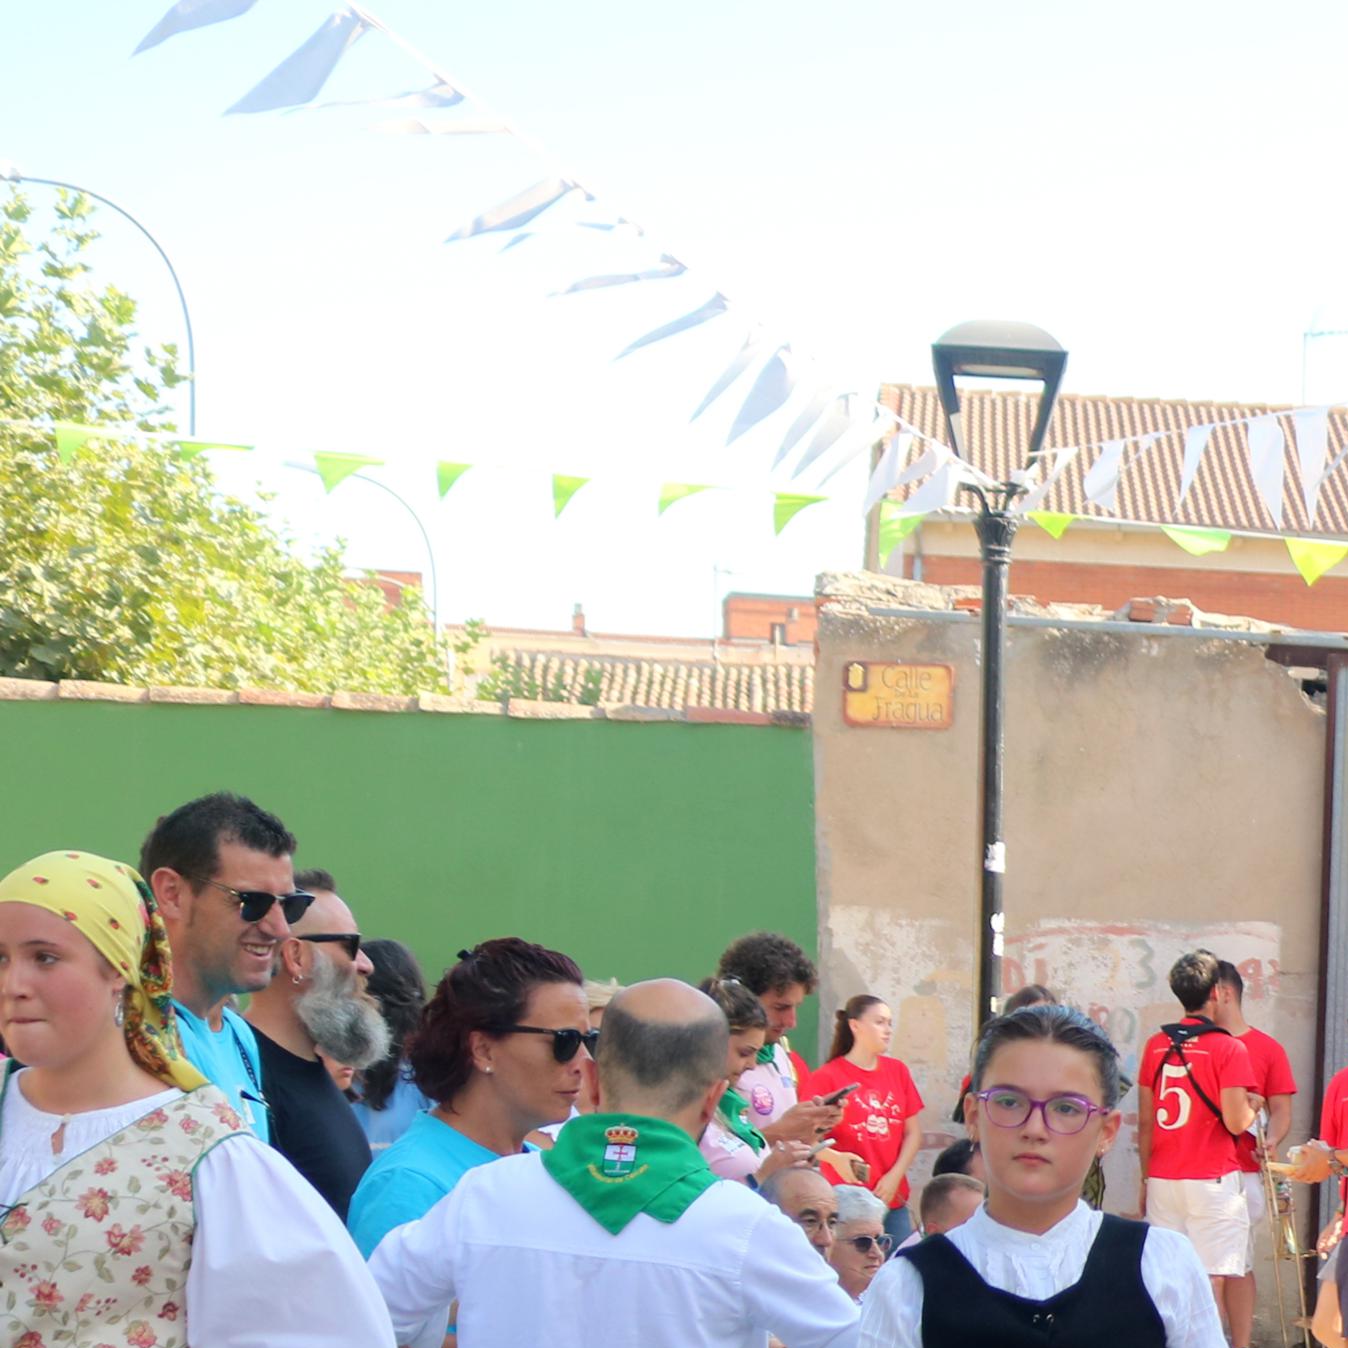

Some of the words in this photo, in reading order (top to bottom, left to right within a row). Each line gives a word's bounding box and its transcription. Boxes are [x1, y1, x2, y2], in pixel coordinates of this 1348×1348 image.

[882, 666, 932, 690] Calle
[872, 696, 944, 723] Fragua
[1156, 1062, 1193, 1131] 5
